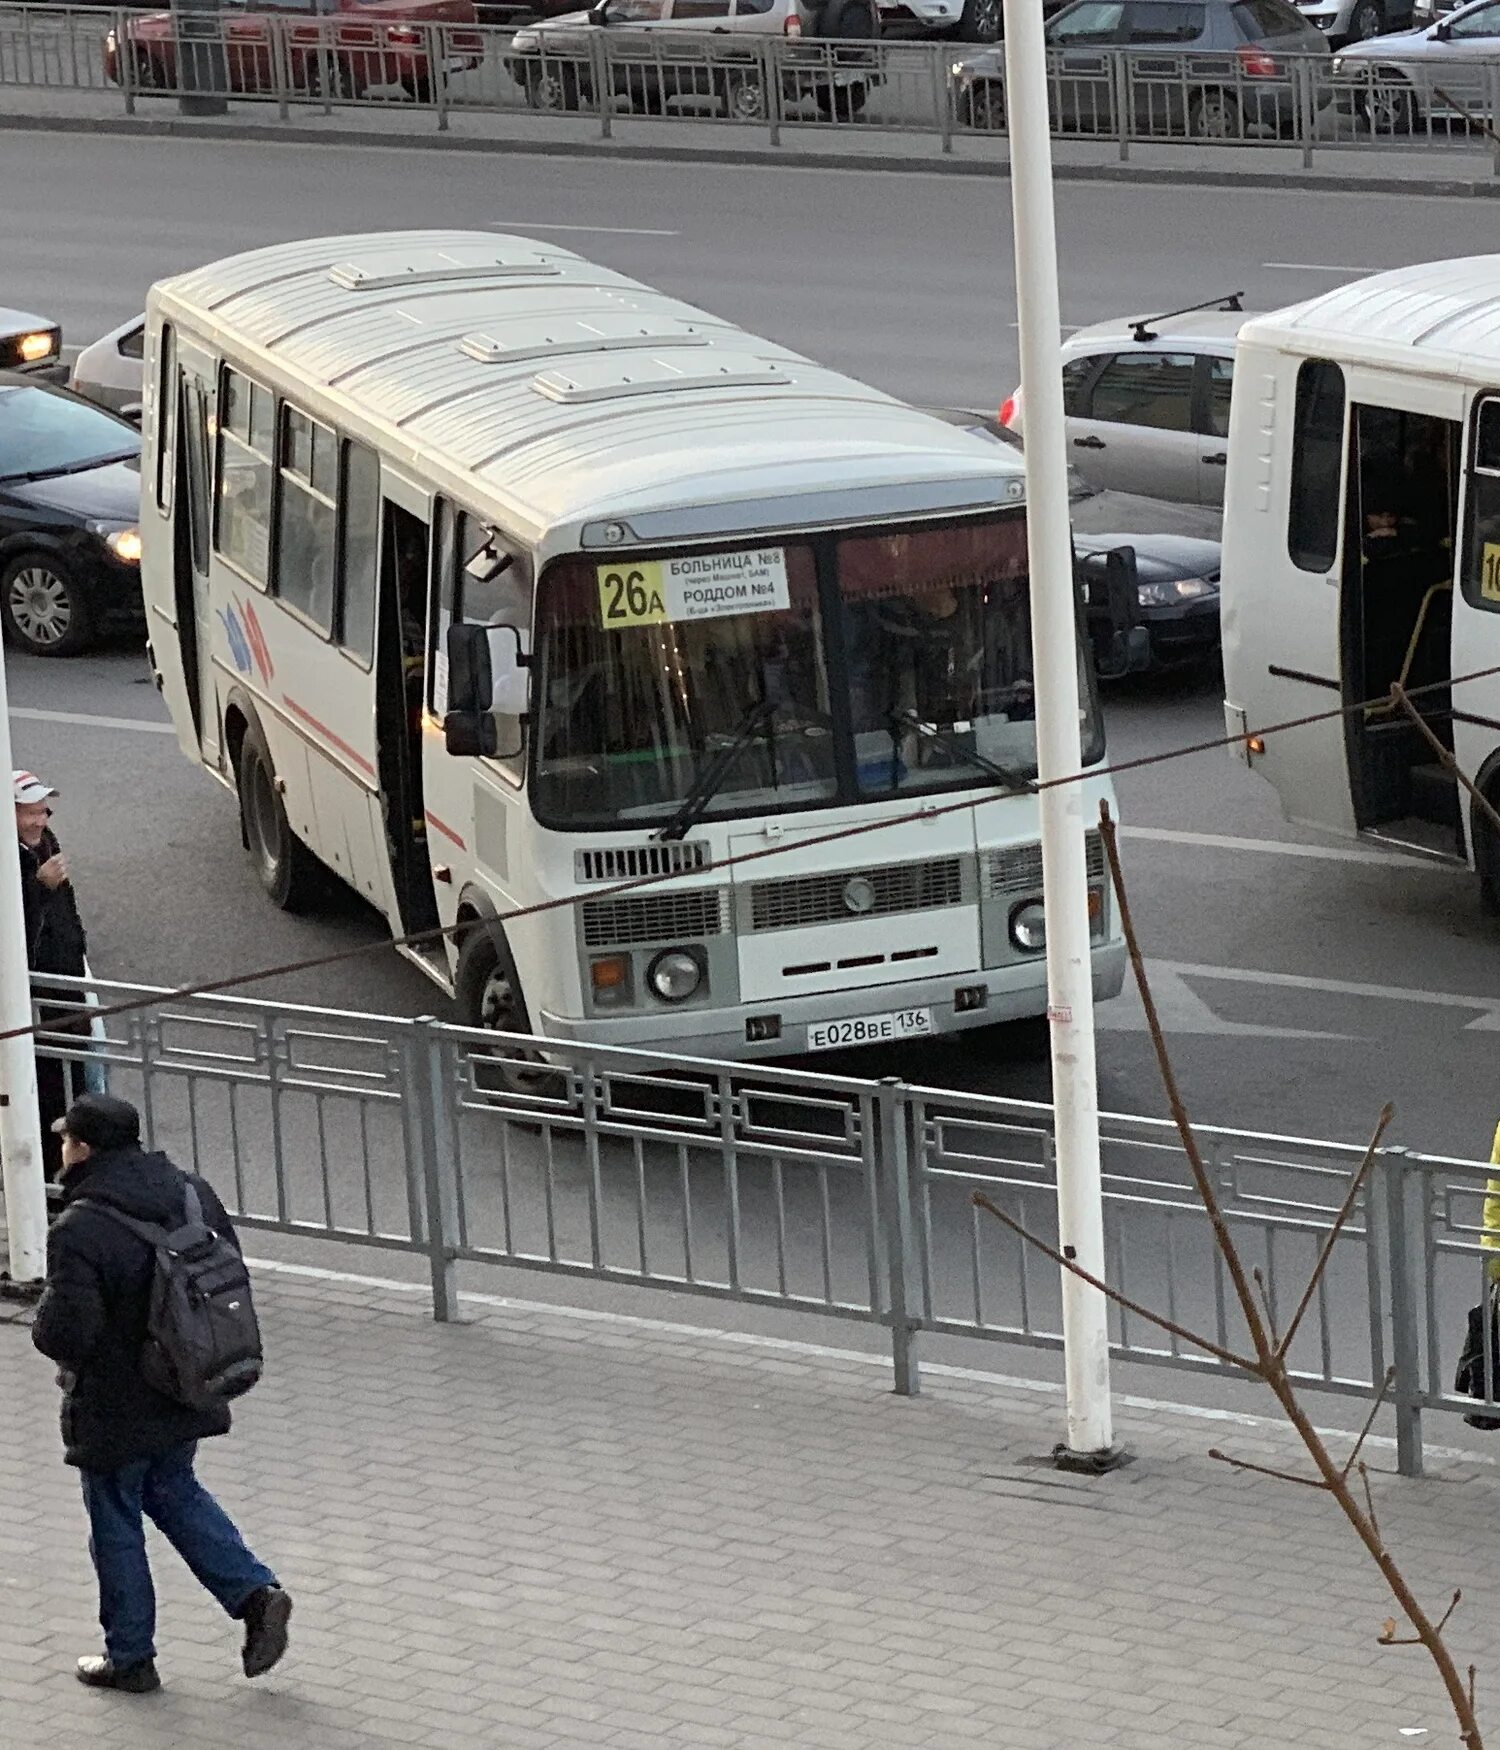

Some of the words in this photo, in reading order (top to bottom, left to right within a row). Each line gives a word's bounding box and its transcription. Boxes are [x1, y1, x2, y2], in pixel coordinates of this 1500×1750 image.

[671, 555, 752, 576] БОЛЬНИЦА
[605, 570, 665, 618] 26А
[684, 585, 747, 603] РОДДОМ
[751, 581, 775, 596] №4
[814, 1021, 892, 1047] Е028ВЕ
[896, 1012, 925, 1029] 136
